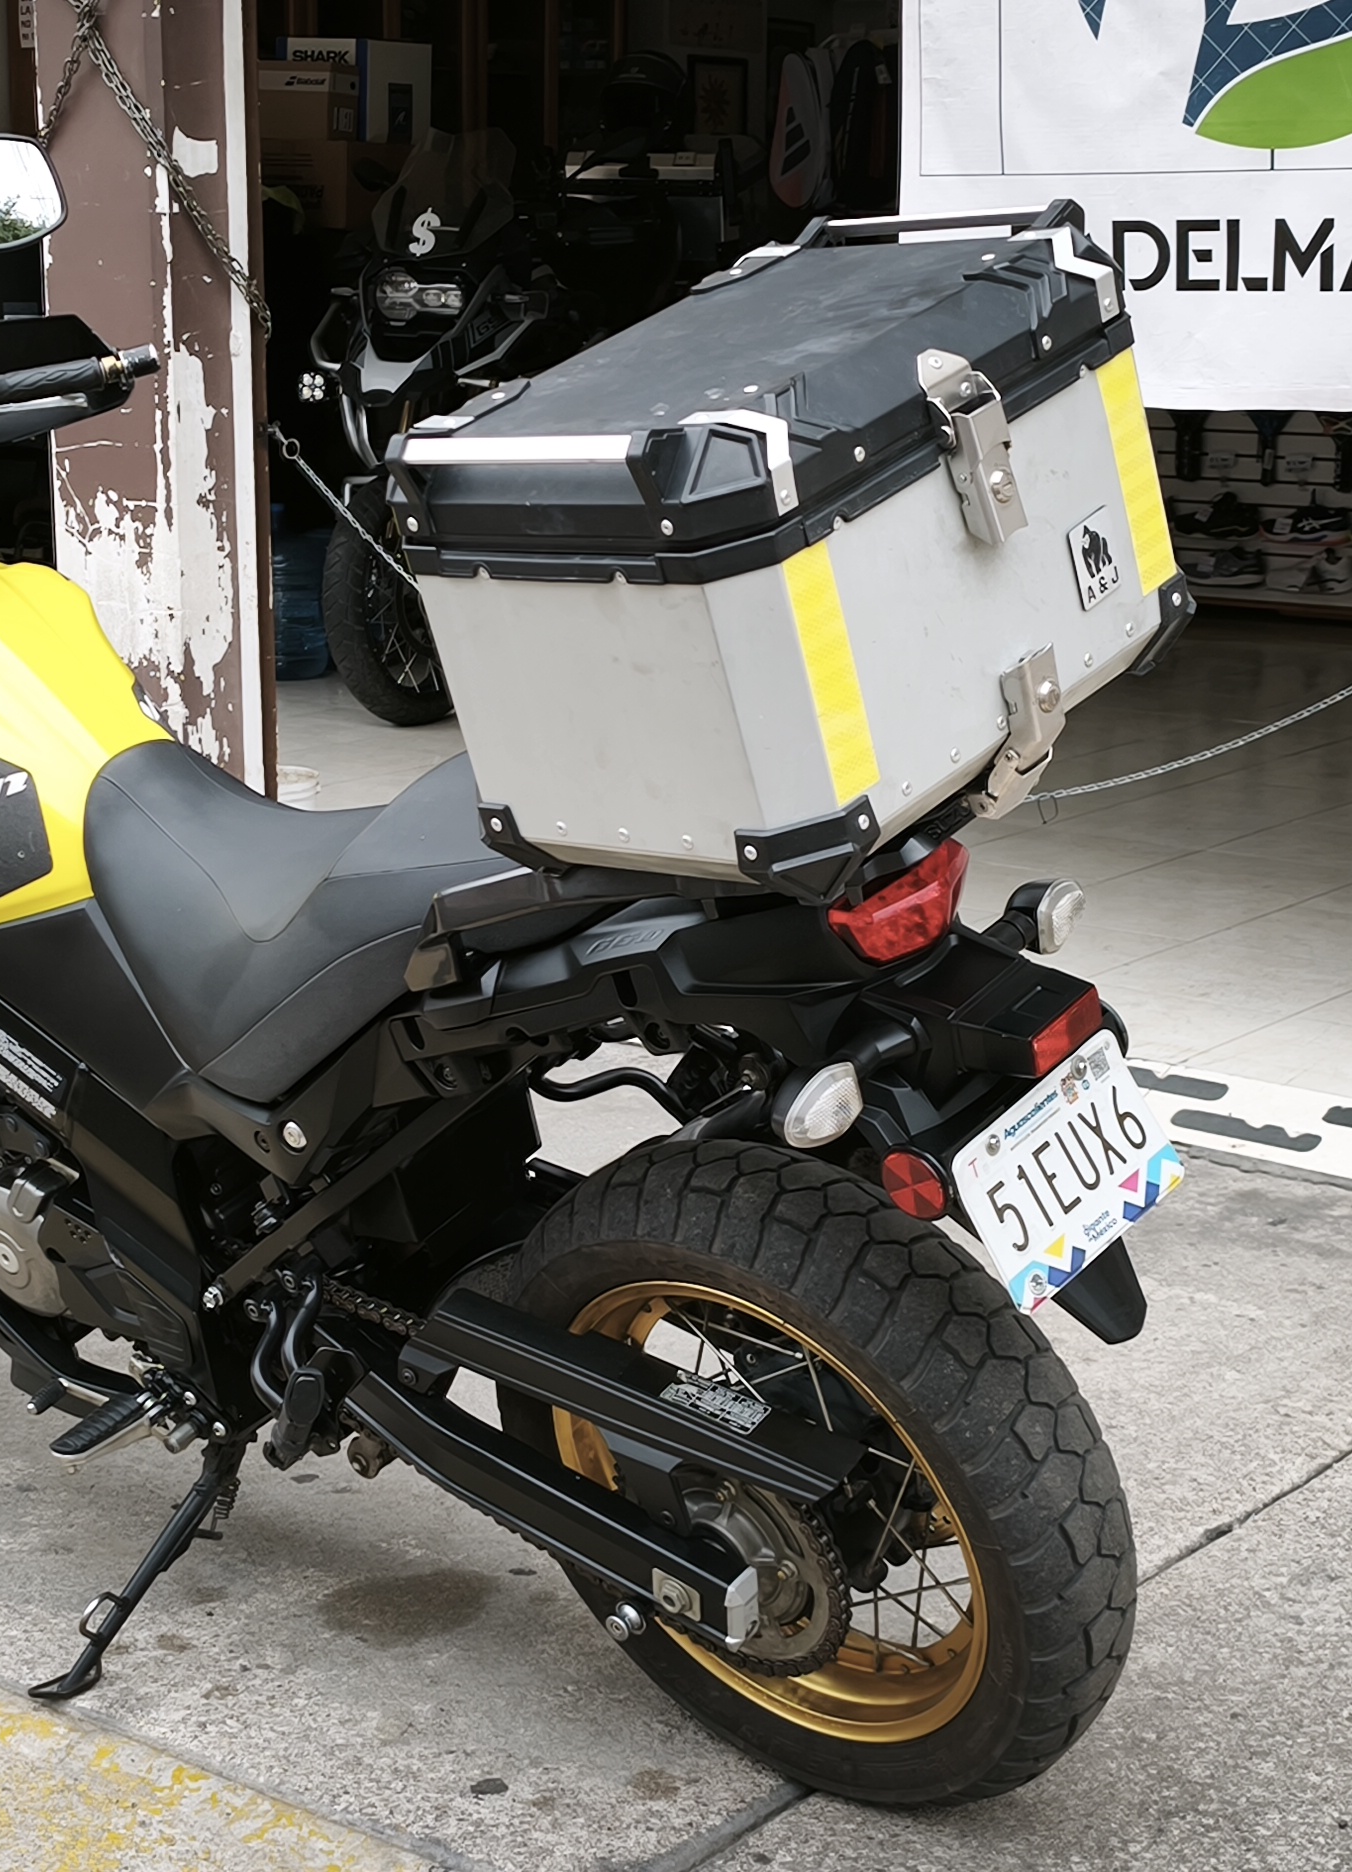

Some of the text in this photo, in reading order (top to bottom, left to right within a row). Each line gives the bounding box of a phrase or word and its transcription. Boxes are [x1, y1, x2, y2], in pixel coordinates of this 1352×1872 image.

[292, 50, 349, 64] SHARK
[1088, 565, 1119, 604] A & J
[986, 1085, 1147, 1252] 51EUX6
